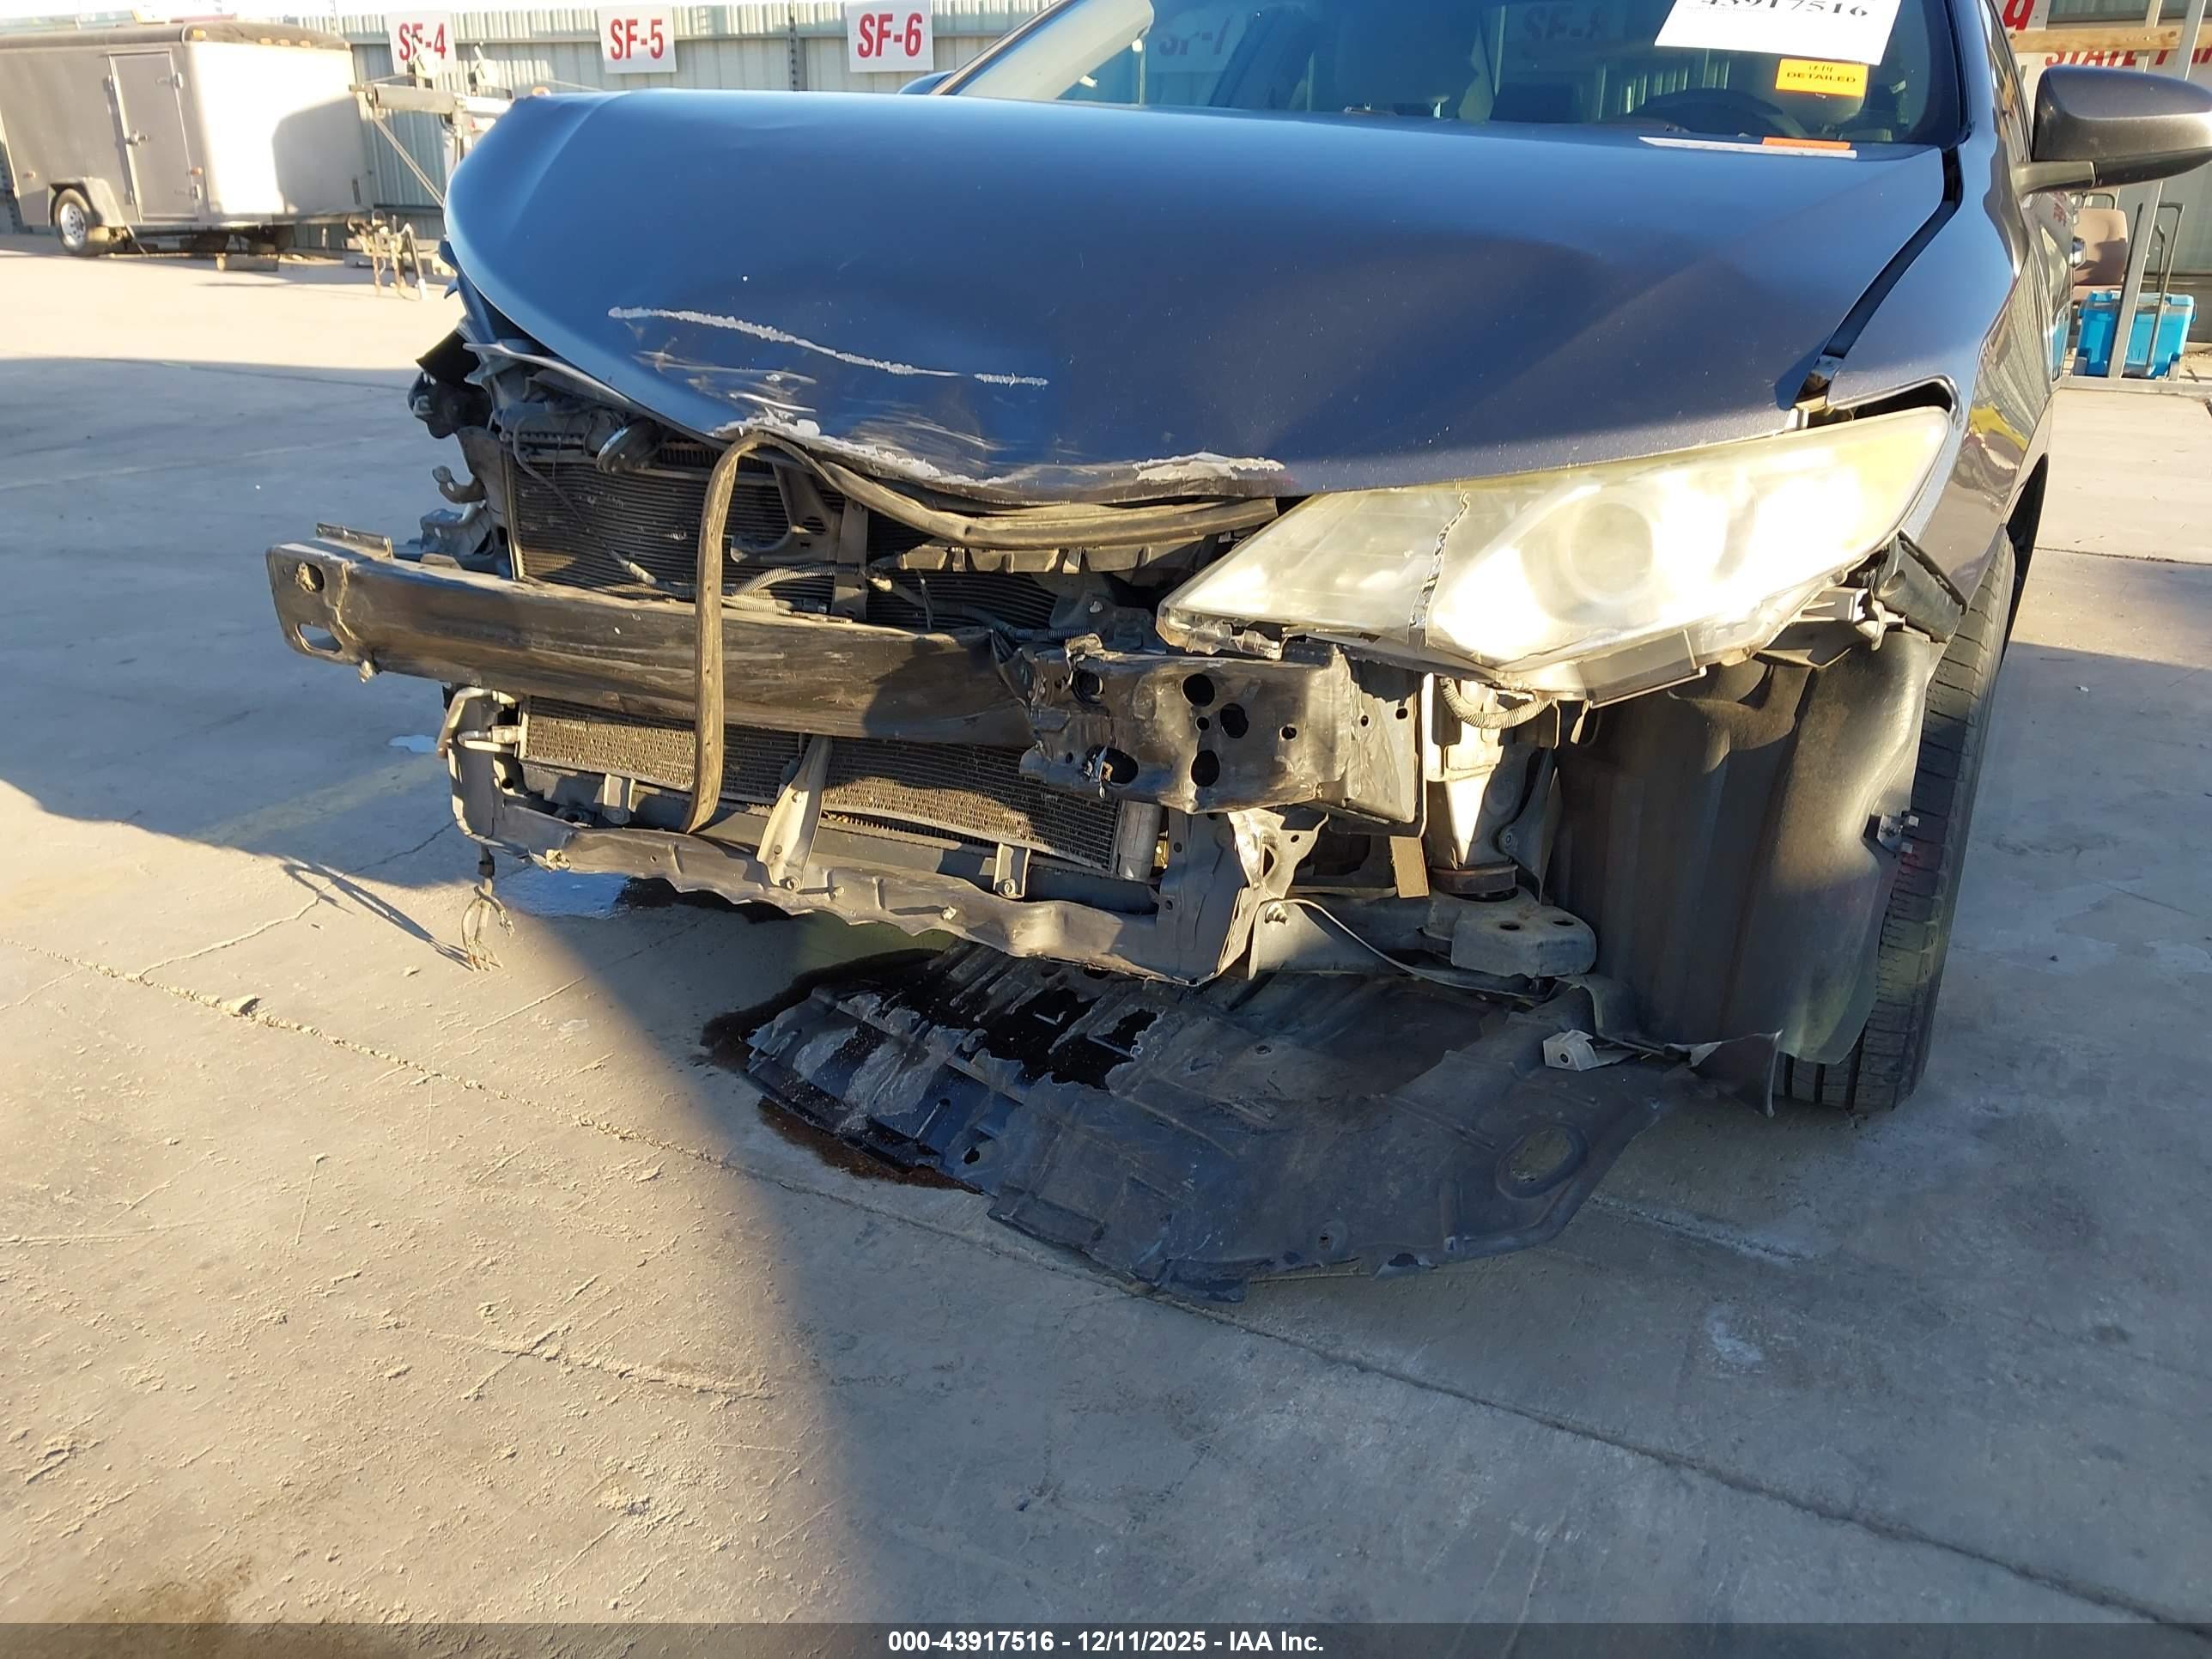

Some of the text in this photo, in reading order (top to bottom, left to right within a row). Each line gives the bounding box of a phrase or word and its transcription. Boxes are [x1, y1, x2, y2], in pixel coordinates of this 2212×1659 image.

[398, 22, 447, 61] SF-4
[611, 18, 664, 60] SF-5
[857, 13, 922, 58] SF-6
[1786, 71, 1856, 83] DETAILED
